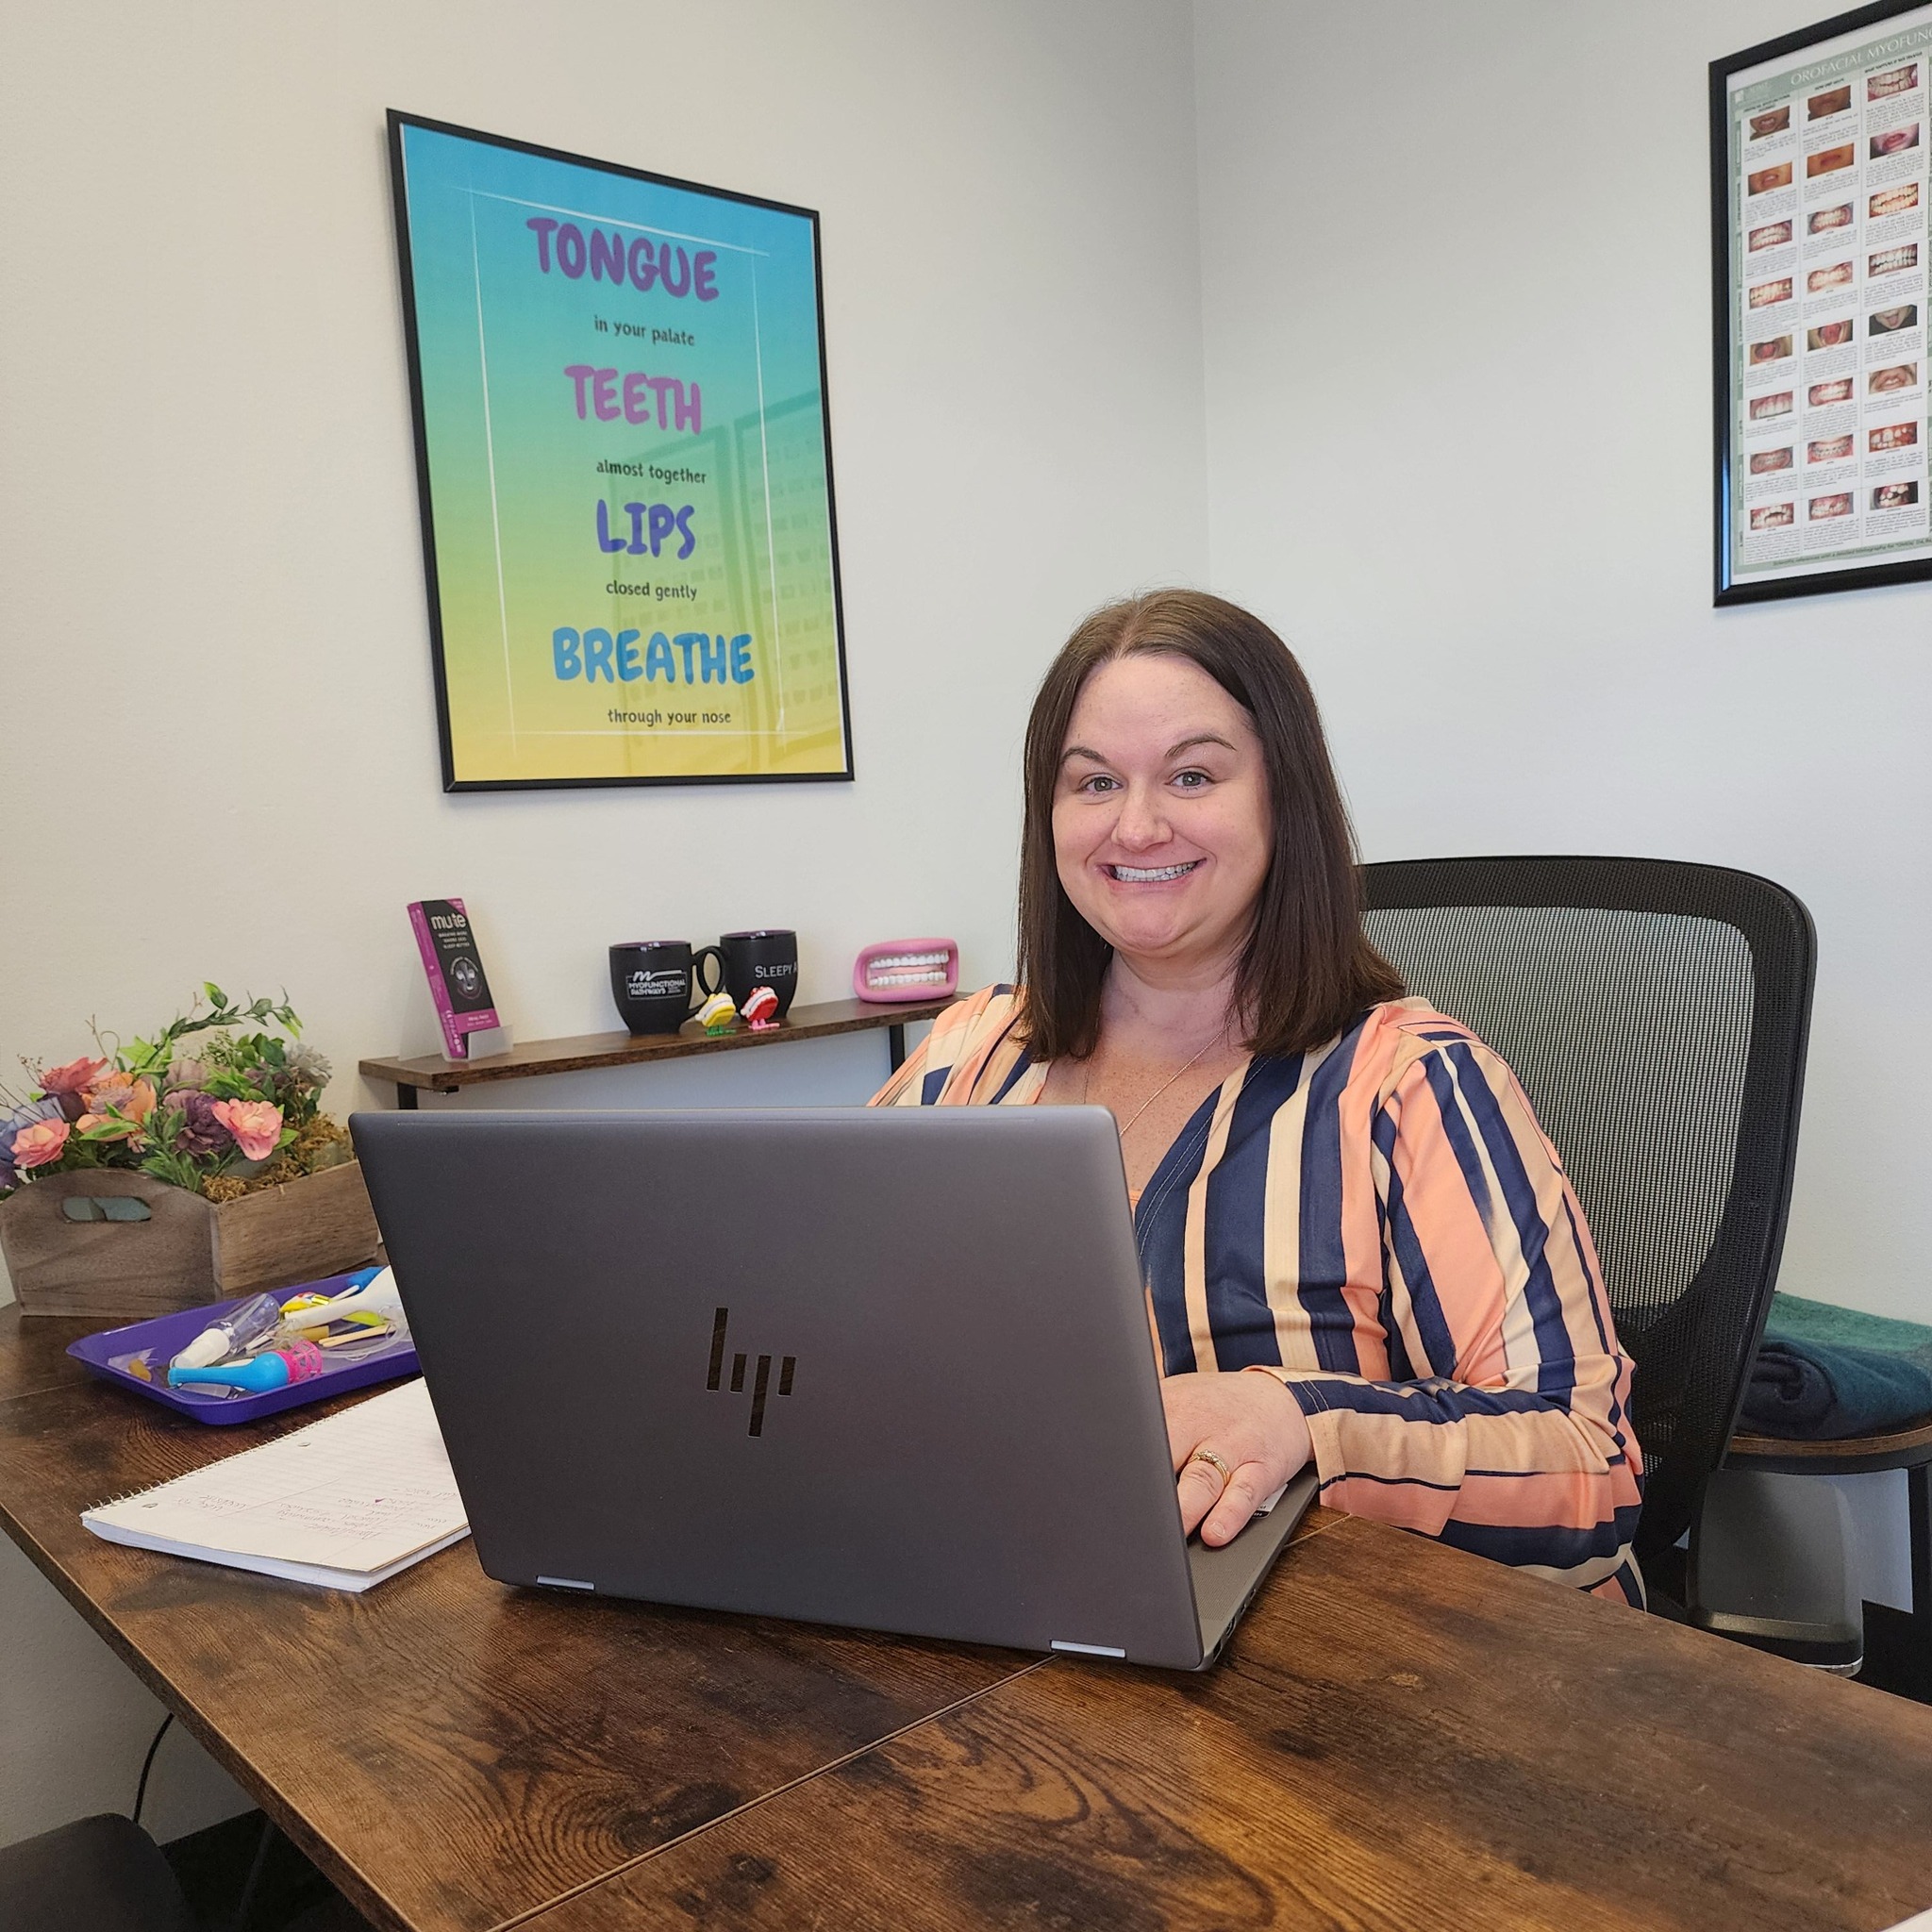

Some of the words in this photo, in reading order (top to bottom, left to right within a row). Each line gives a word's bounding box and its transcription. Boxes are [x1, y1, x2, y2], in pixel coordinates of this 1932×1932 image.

[1790, 52, 1861, 85] OROFACIAL
[525, 217, 720, 302] TONGUE
[594, 314, 608, 332] in
[613, 320, 646, 340] your
[652, 325, 695, 346] palate
[564, 364, 702, 435] TEETH
[596, 458, 644, 478] almost
[648, 464, 707, 485] together
[596, 499, 696, 560] LIPS
[606, 579, 651, 598] closed
[655, 583, 698, 602] gently
[552, 626, 756, 685] BREATHE
[608, 708, 662, 727] through
[667, 711, 697, 726] your
[701, 710, 732, 724] nose
[430, 912, 467, 930] mute
[628, 978, 686, 990] MYOFUNCTIONAL
[755, 962, 792, 979] SLEEPY
[707, 1307, 797, 1439] hp
